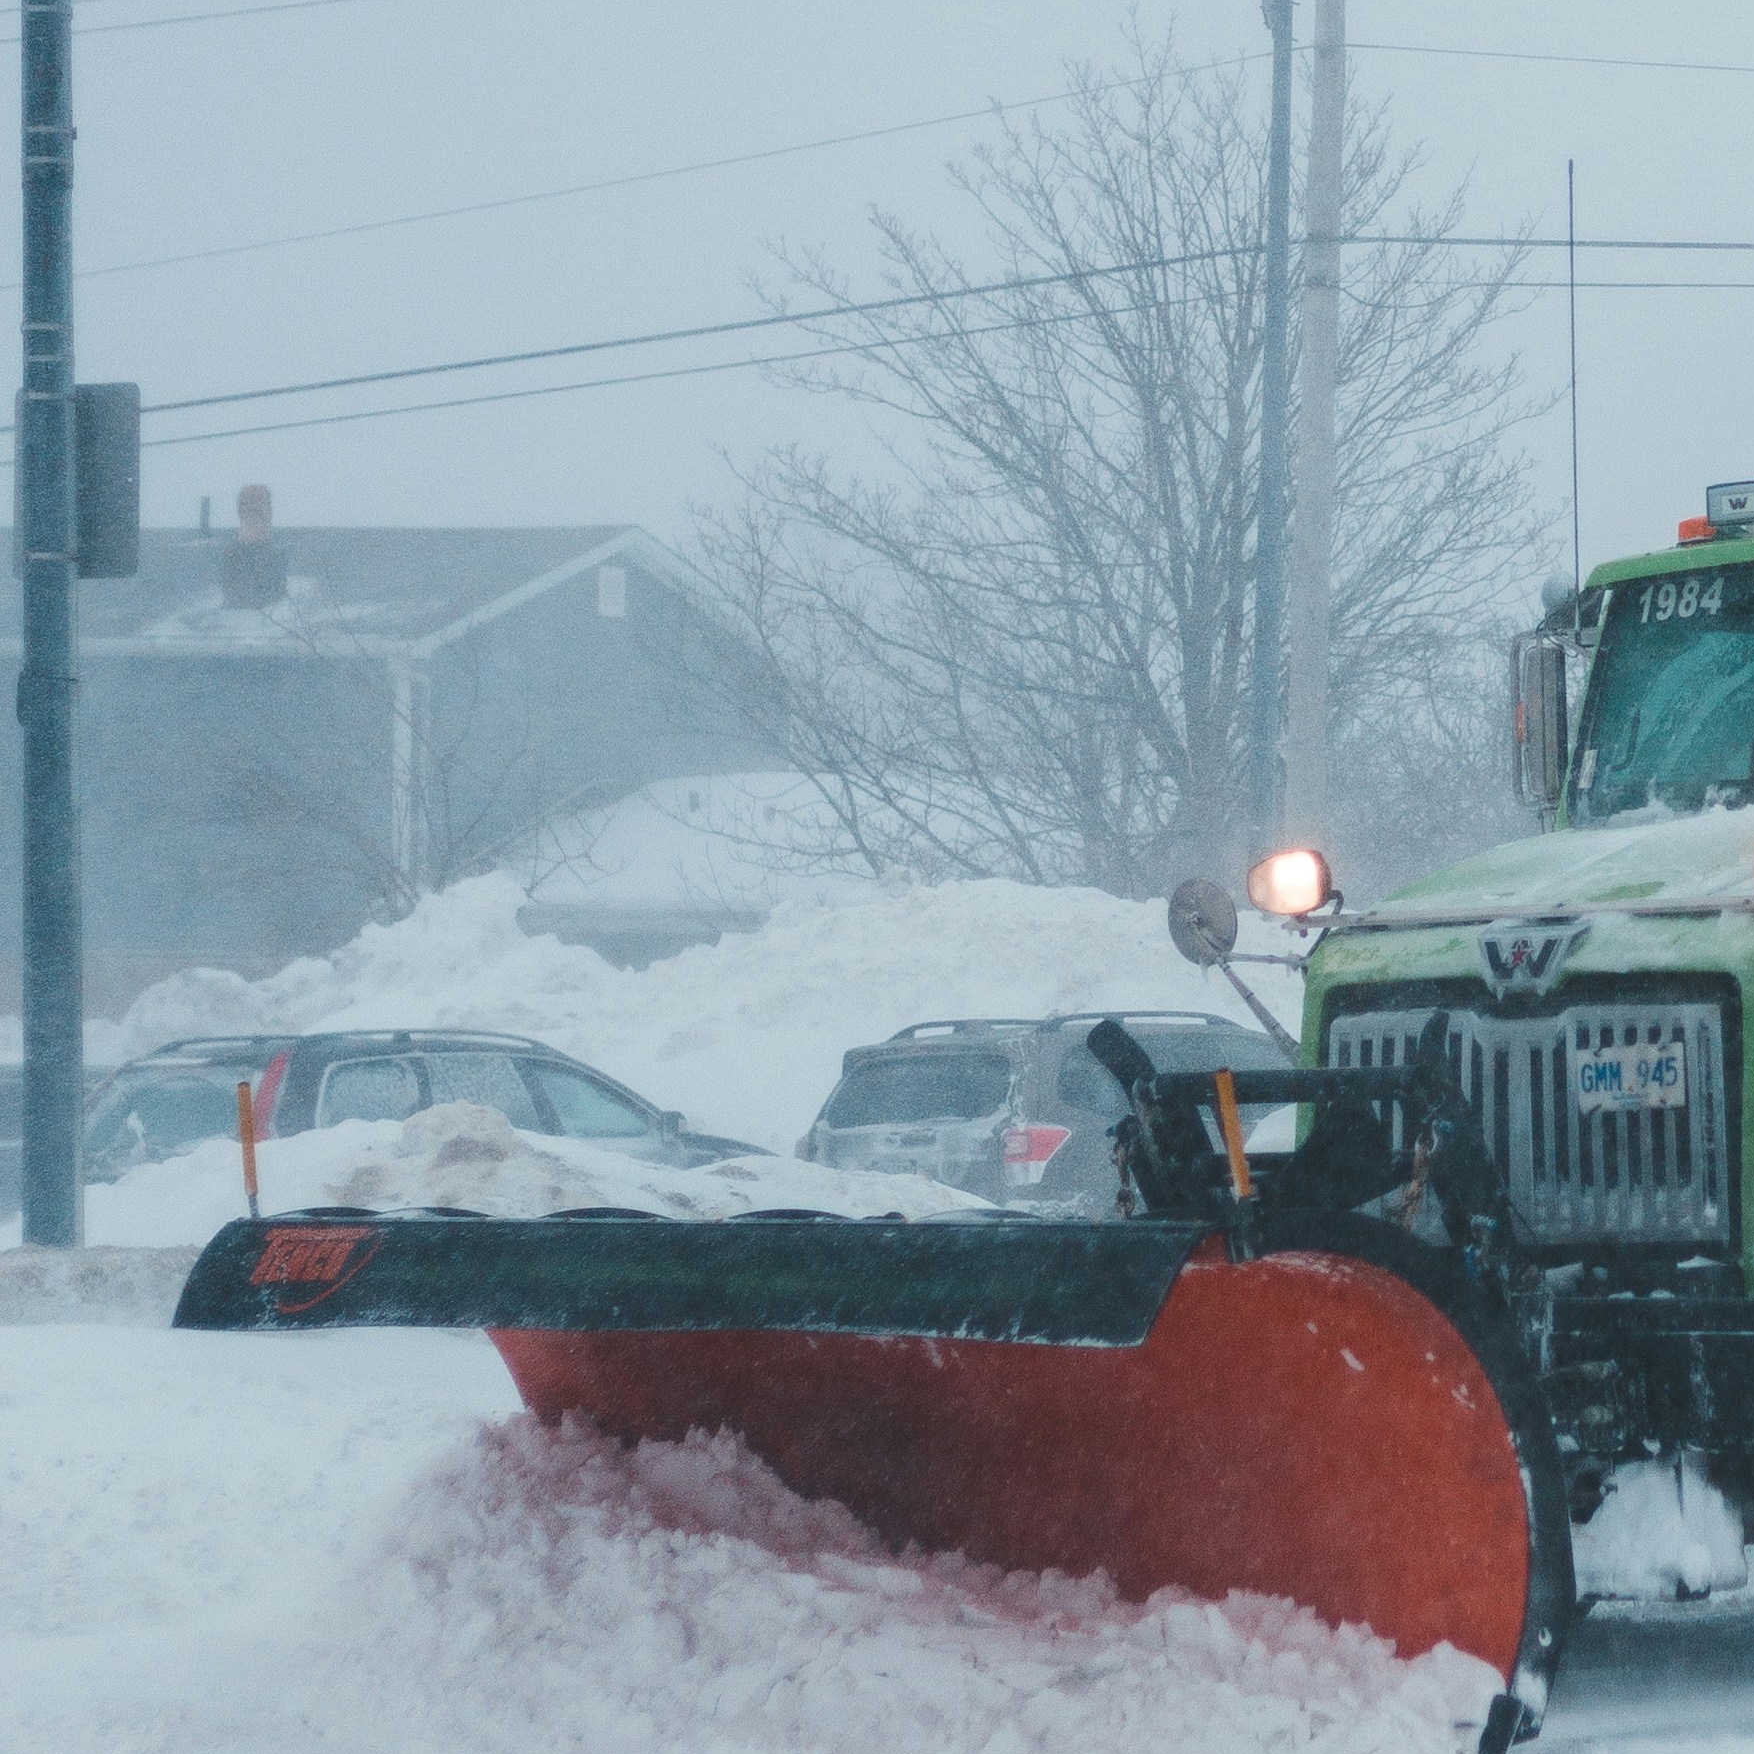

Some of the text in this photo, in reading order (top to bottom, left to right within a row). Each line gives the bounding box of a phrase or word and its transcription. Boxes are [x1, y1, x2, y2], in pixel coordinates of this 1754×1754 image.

[1640, 577, 1725, 623] 1984
[1581, 1056, 1678, 1093] GMM 945
